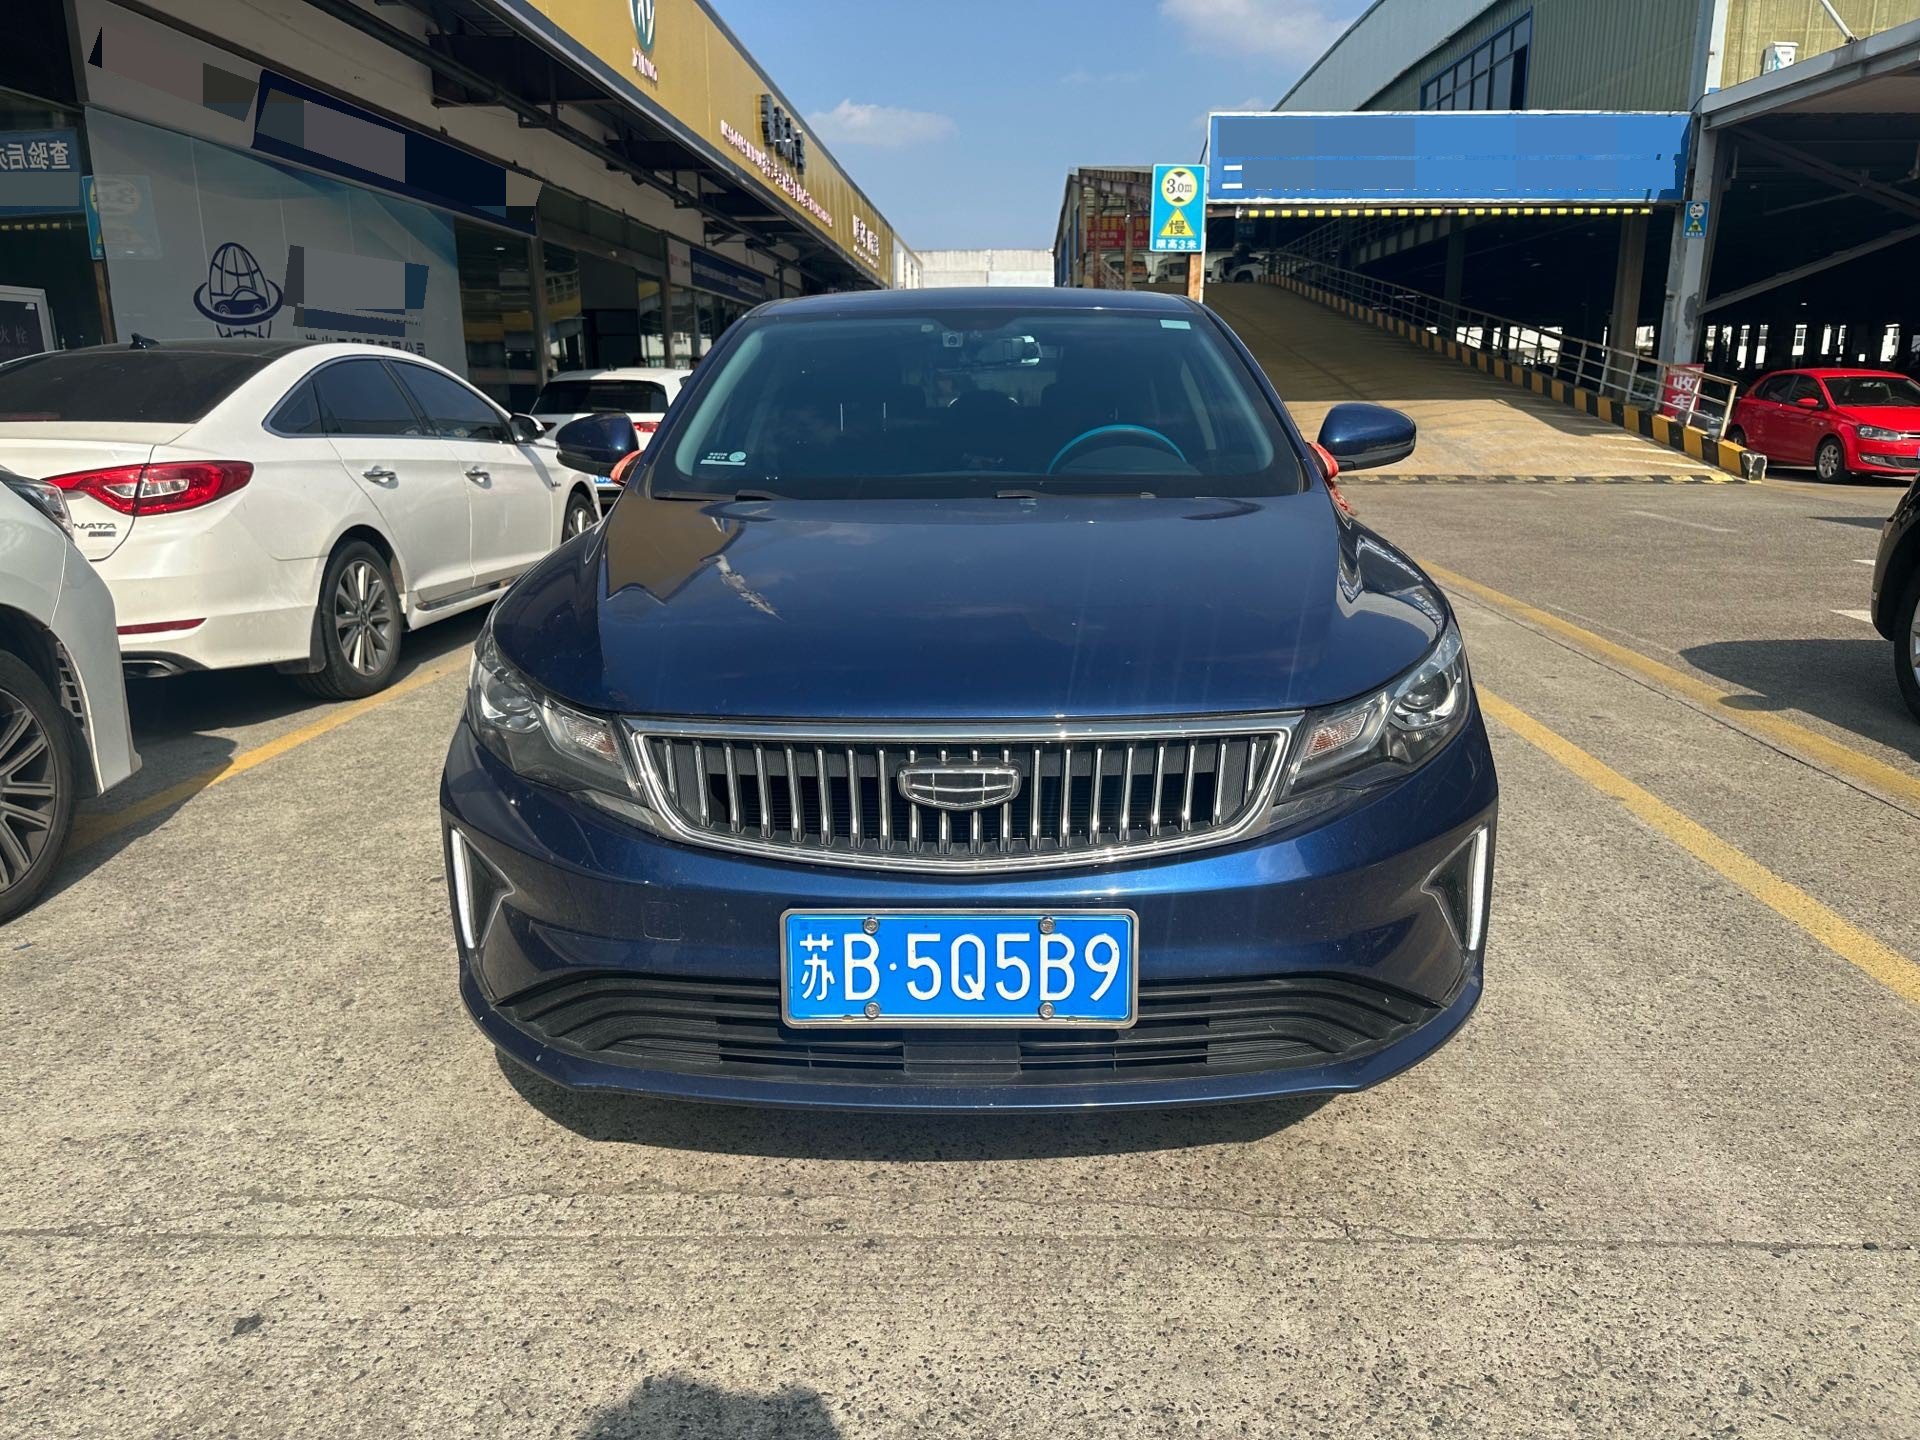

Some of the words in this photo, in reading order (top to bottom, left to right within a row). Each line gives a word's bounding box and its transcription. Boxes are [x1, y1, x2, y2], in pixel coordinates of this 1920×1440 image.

[1169, 220, 1186, 235] 慢
[1156, 239, 1197, 250] 限高3米
[799, 933, 1120, 1001] 苏B·5Q5B9
